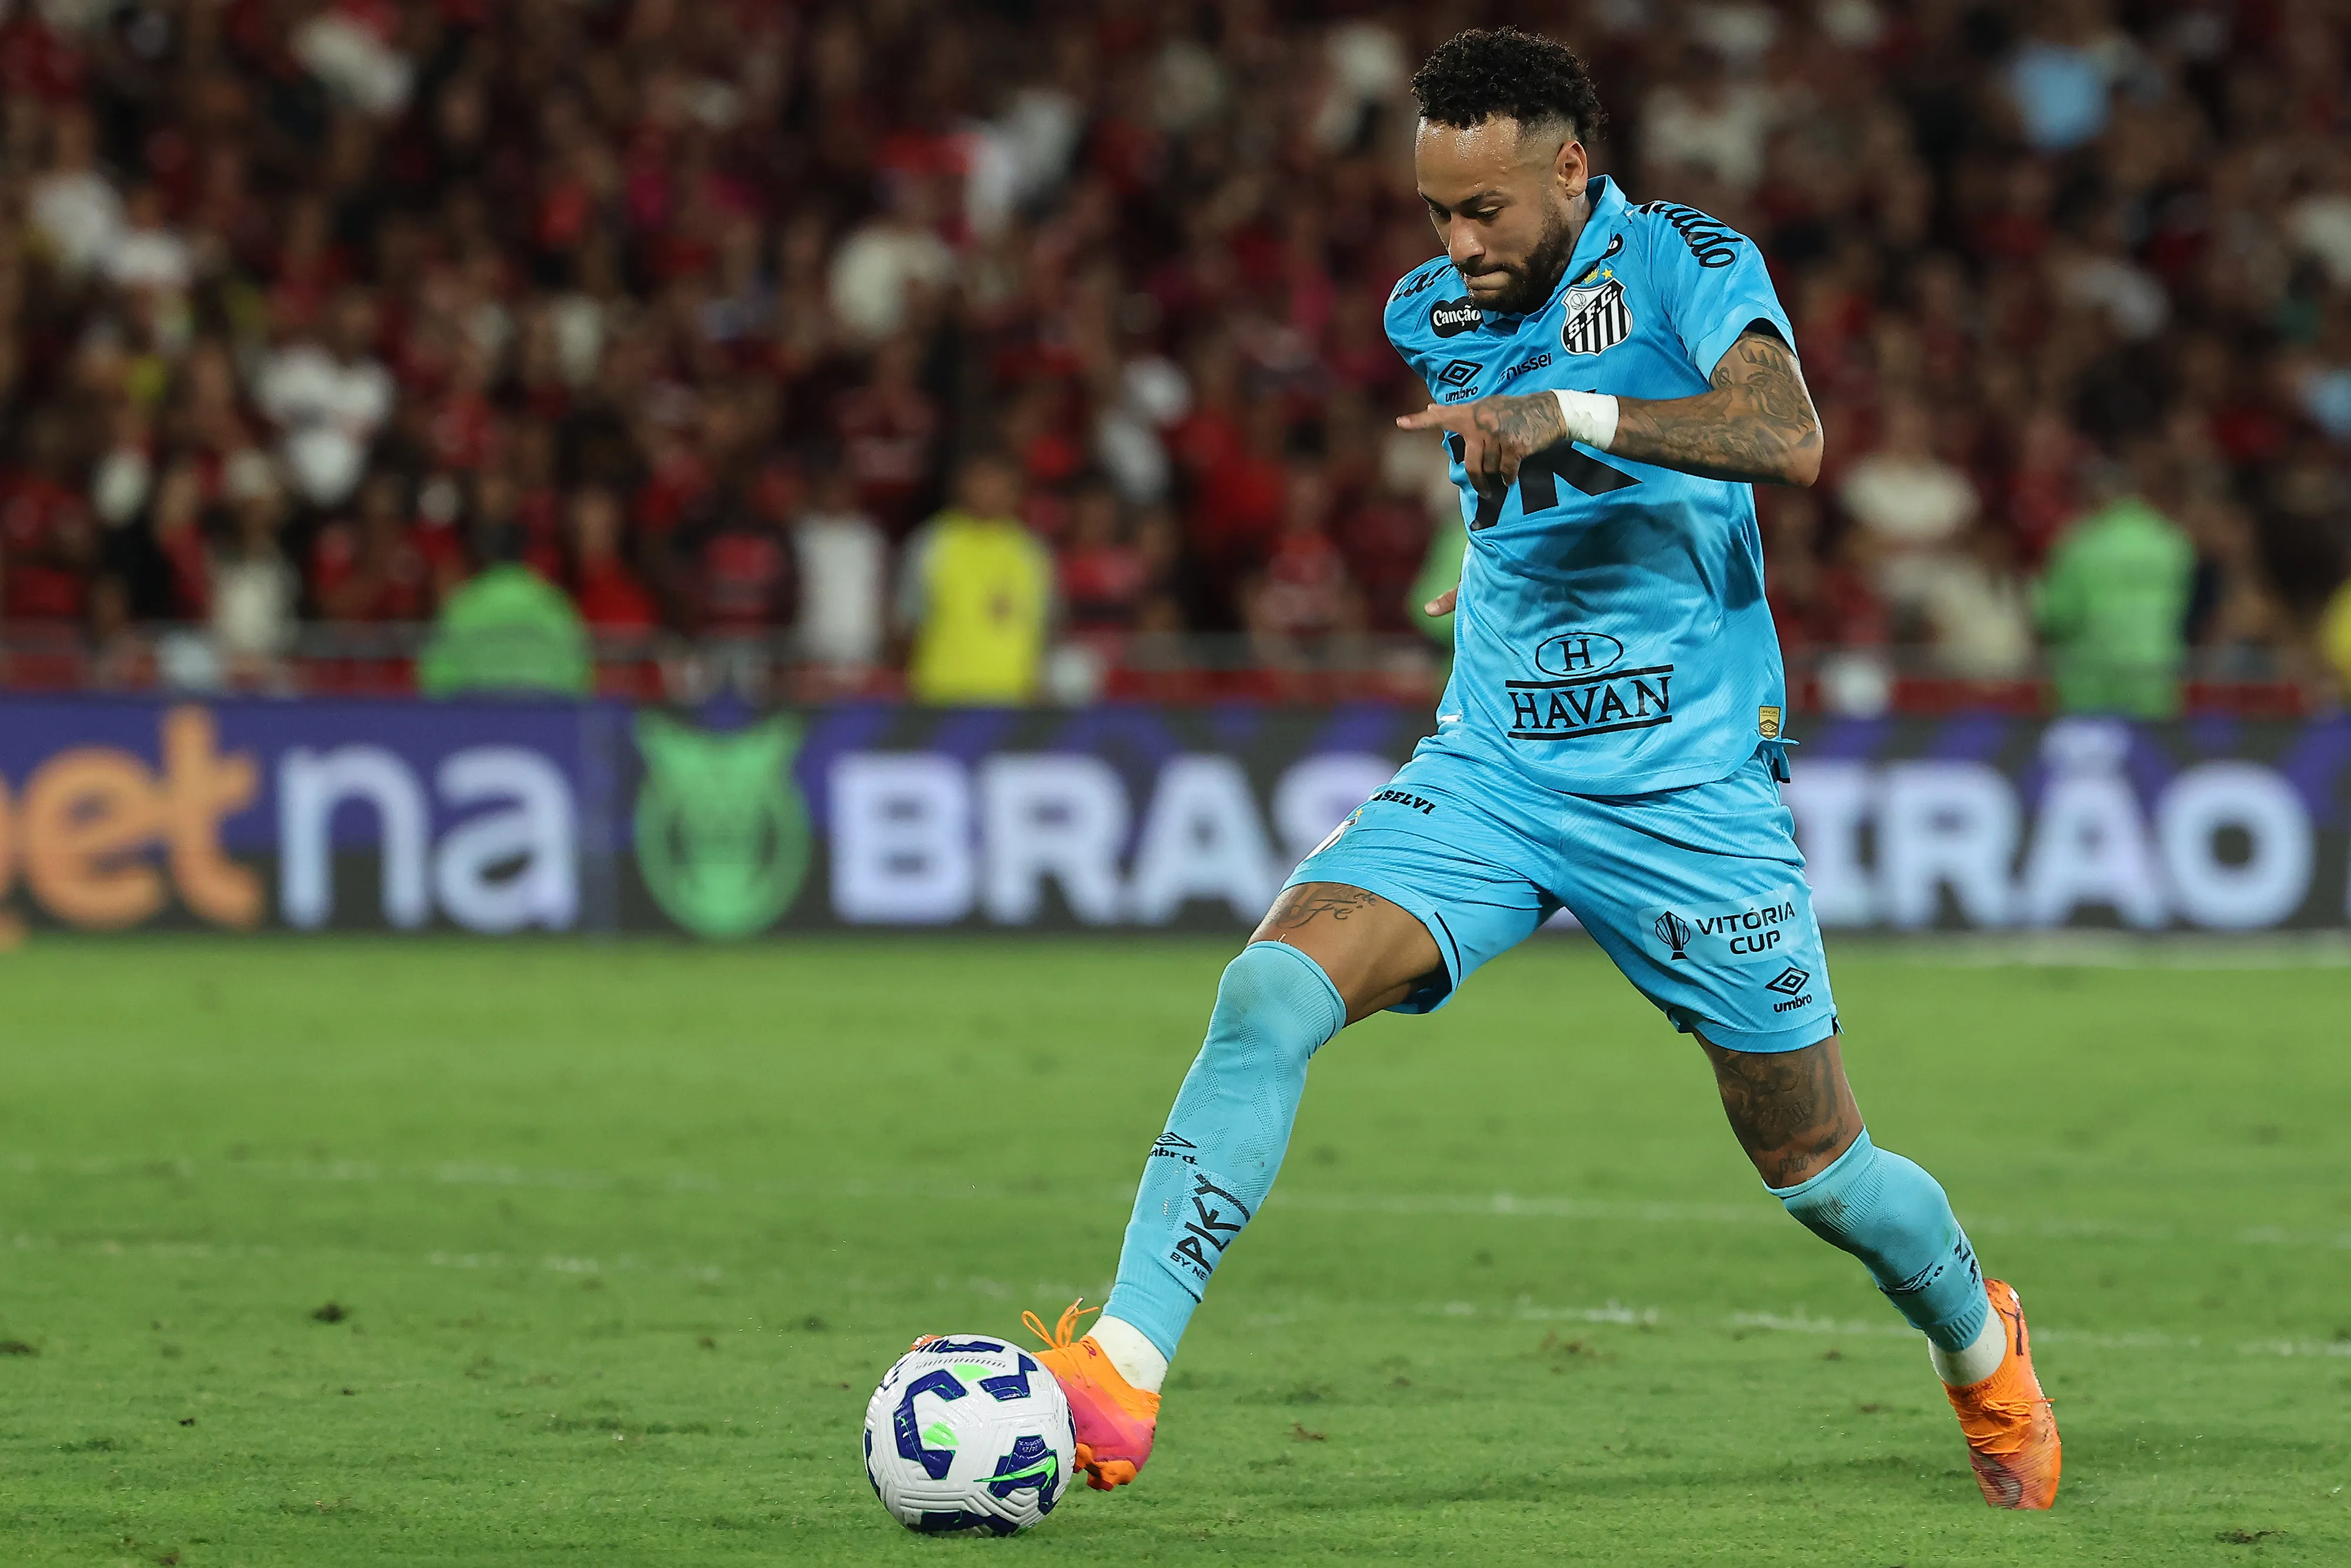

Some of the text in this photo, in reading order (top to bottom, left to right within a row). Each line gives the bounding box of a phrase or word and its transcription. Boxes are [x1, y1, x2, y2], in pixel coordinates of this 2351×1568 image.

[1432, 304, 1482, 327] Canção
[1445, 386, 1479, 403] umbro
[1558, 638, 1592, 672] H
[1506, 676, 1672, 729] HAVAN
[1694, 901, 1796, 936] VITÓRIA
[1729, 929, 1781, 955] CUP
[1773, 993, 1813, 1014] umbro
[1170, 1251, 1208, 1281] BY NE
